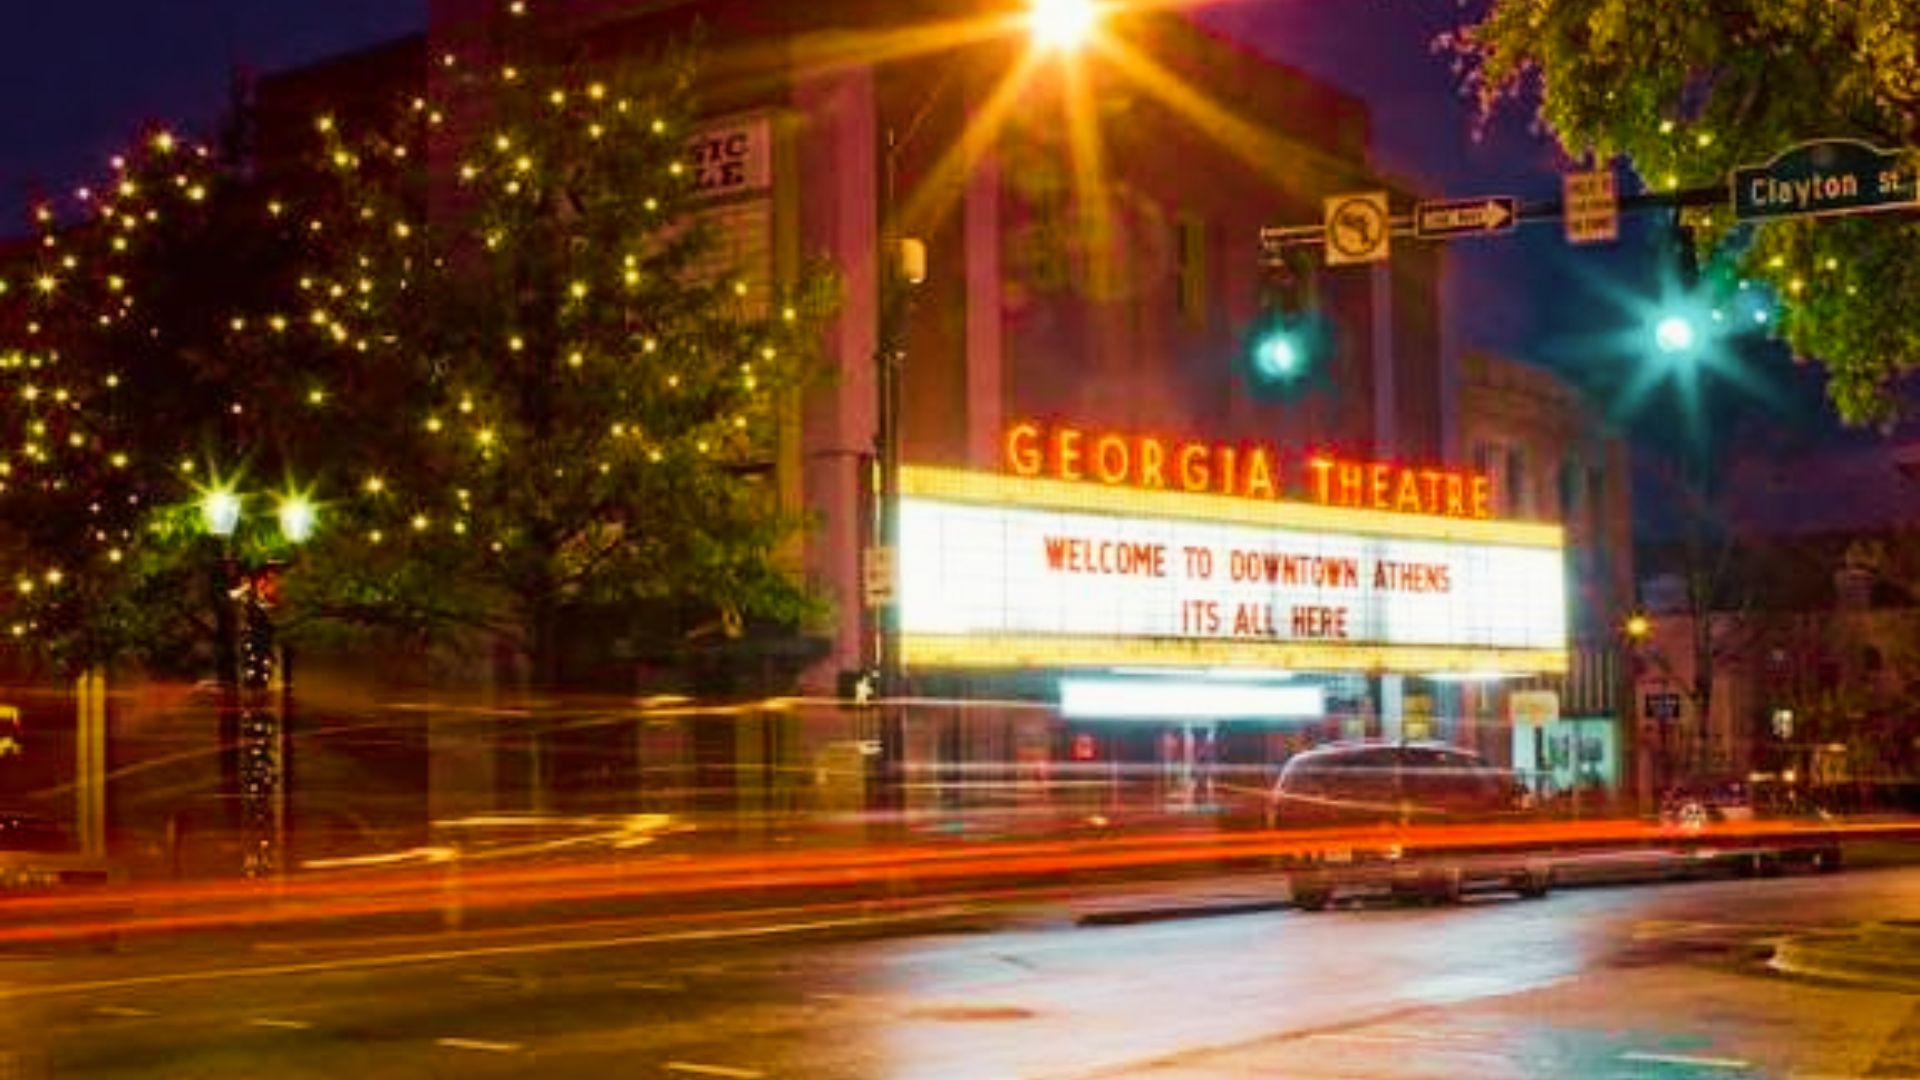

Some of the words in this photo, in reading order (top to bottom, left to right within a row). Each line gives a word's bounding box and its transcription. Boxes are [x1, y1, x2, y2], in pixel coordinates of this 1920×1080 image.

[1752, 173, 1858, 208] Clayton
[1008, 425, 1276, 499] GEORGIA
[1309, 458, 1490, 519] THEATRE
[1044, 536, 1167, 577] WELCOME
[1183, 546, 1213, 580] TO
[1230, 549, 1360, 588] DOWNTOWN
[1373, 558, 1452, 593] ATHENS
[1183, 600, 1221, 634] ITS
[1234, 603, 1278, 637] ALL
[1291, 605, 1349, 639] HERE
